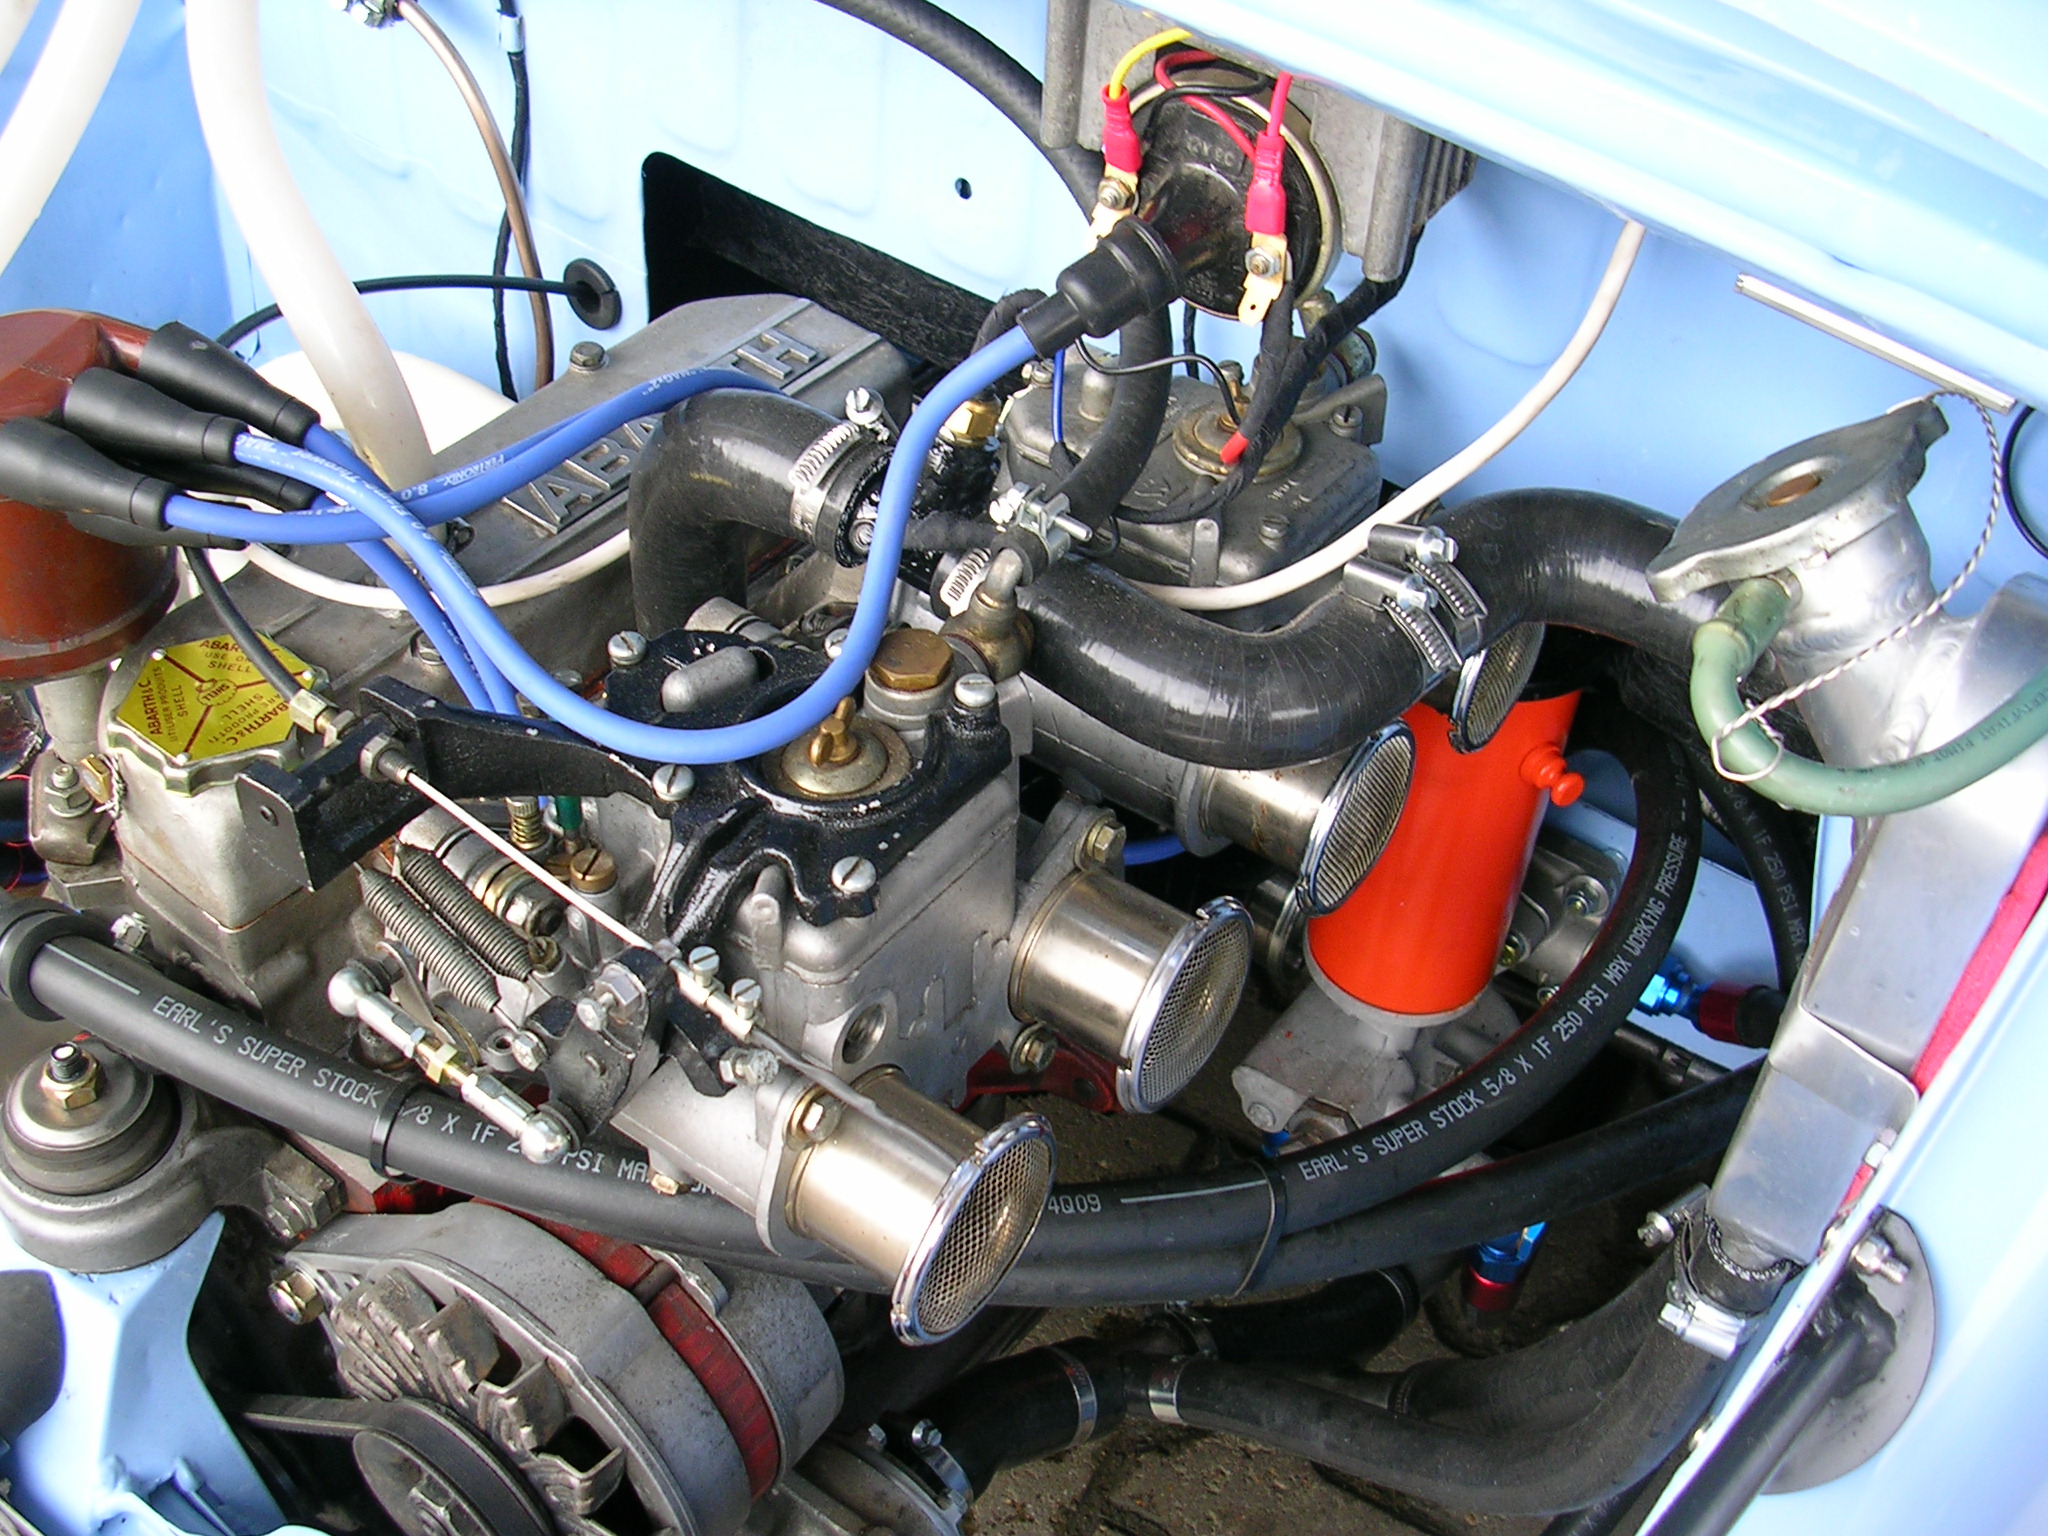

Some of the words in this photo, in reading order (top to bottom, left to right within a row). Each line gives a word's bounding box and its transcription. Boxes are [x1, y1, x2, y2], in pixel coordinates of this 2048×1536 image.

[207, 660, 253, 674] SHELL
[171, 684, 189, 718] SHELL
[204, 684, 231, 702] SHELL
[223, 691, 264, 720] SHELL
[1763, 851, 1787, 882] 250
[1775, 884, 1799, 914] PSI
[1371, 1118, 1429, 1157] SUPER
[1428, 1088, 1485, 1130] STOCK
[1480, 1066, 1517, 1098] 5/8
[1513, 1053, 1534, 1075] X
[1531, 1035, 1553, 1060] 1F
[1551, 1009, 1584, 1043] 250
[1577, 982, 1610, 1015] PSI
[1601, 953, 1633, 987] MAX
[1621, 895, 1666, 958] WORKING
[1654, 832, 1688, 897] PRESSURE
[237, 1035, 308, 1079] SUPER
[312, 1066, 383, 1109] STOCK
[440, 1112, 463, 1135] X
[470, 1120, 500, 1144] 1F
[617, 1160, 650, 1184] MA
